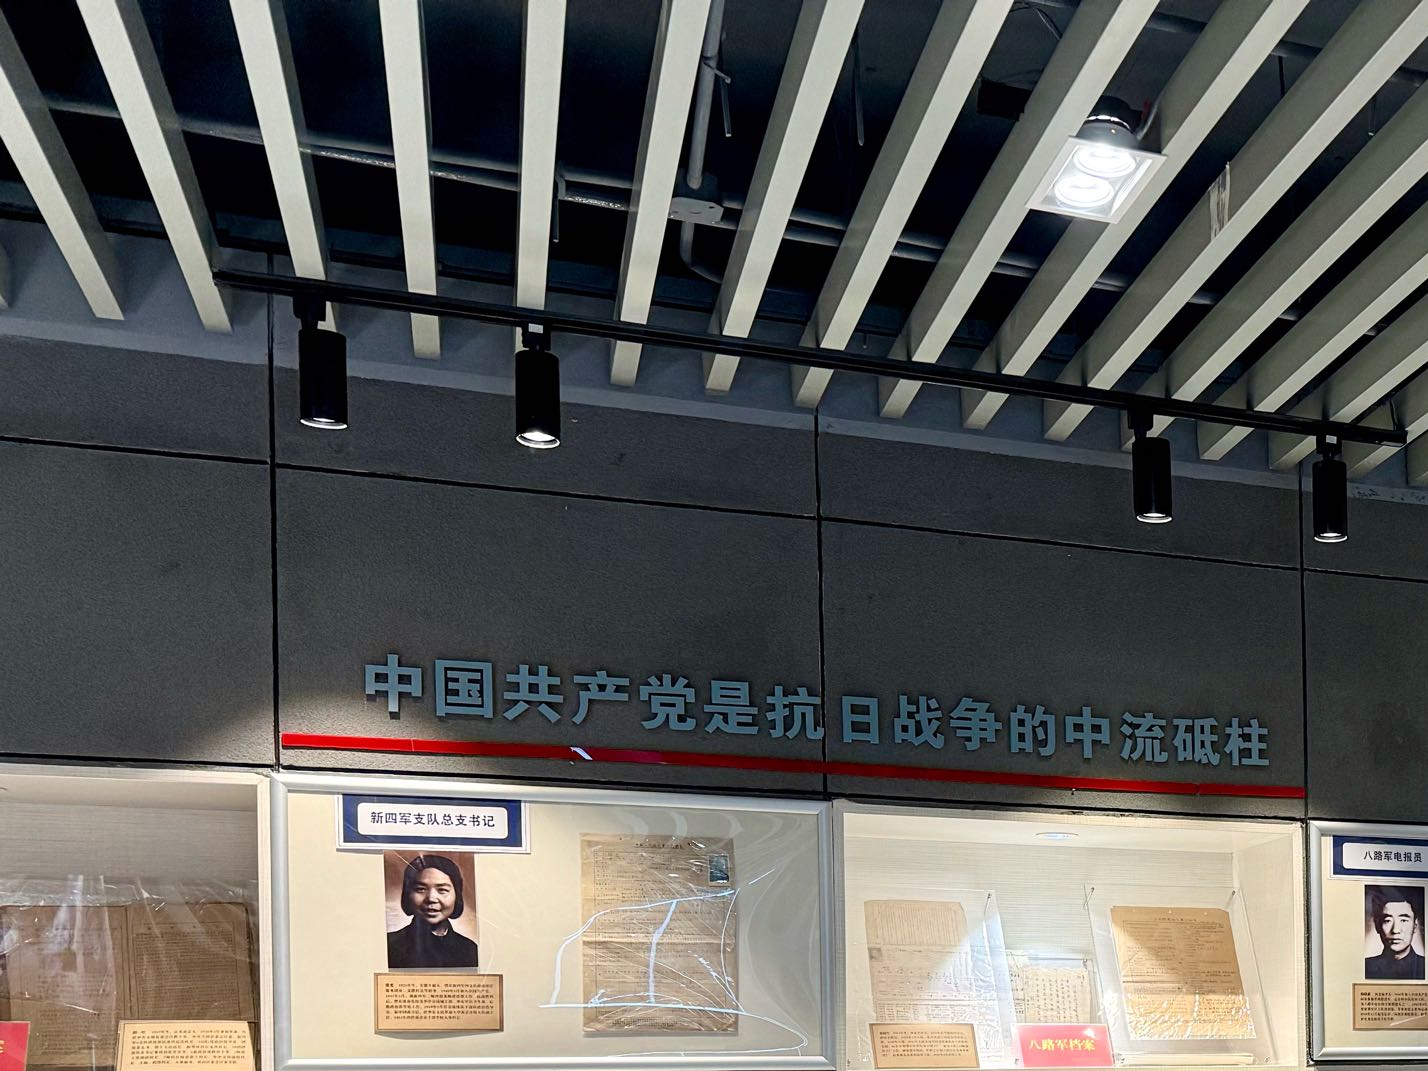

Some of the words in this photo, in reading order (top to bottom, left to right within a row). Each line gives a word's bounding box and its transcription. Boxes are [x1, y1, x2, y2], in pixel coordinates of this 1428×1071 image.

[364, 653, 1270, 767] 中国共产党是抗日战争的中流砥柱
[370, 811, 495, 828] 新四军支队总支书记
[1363, 850, 1423, 863] 八路军电报员
[1029, 1038, 1096, 1052] 八路军档案
